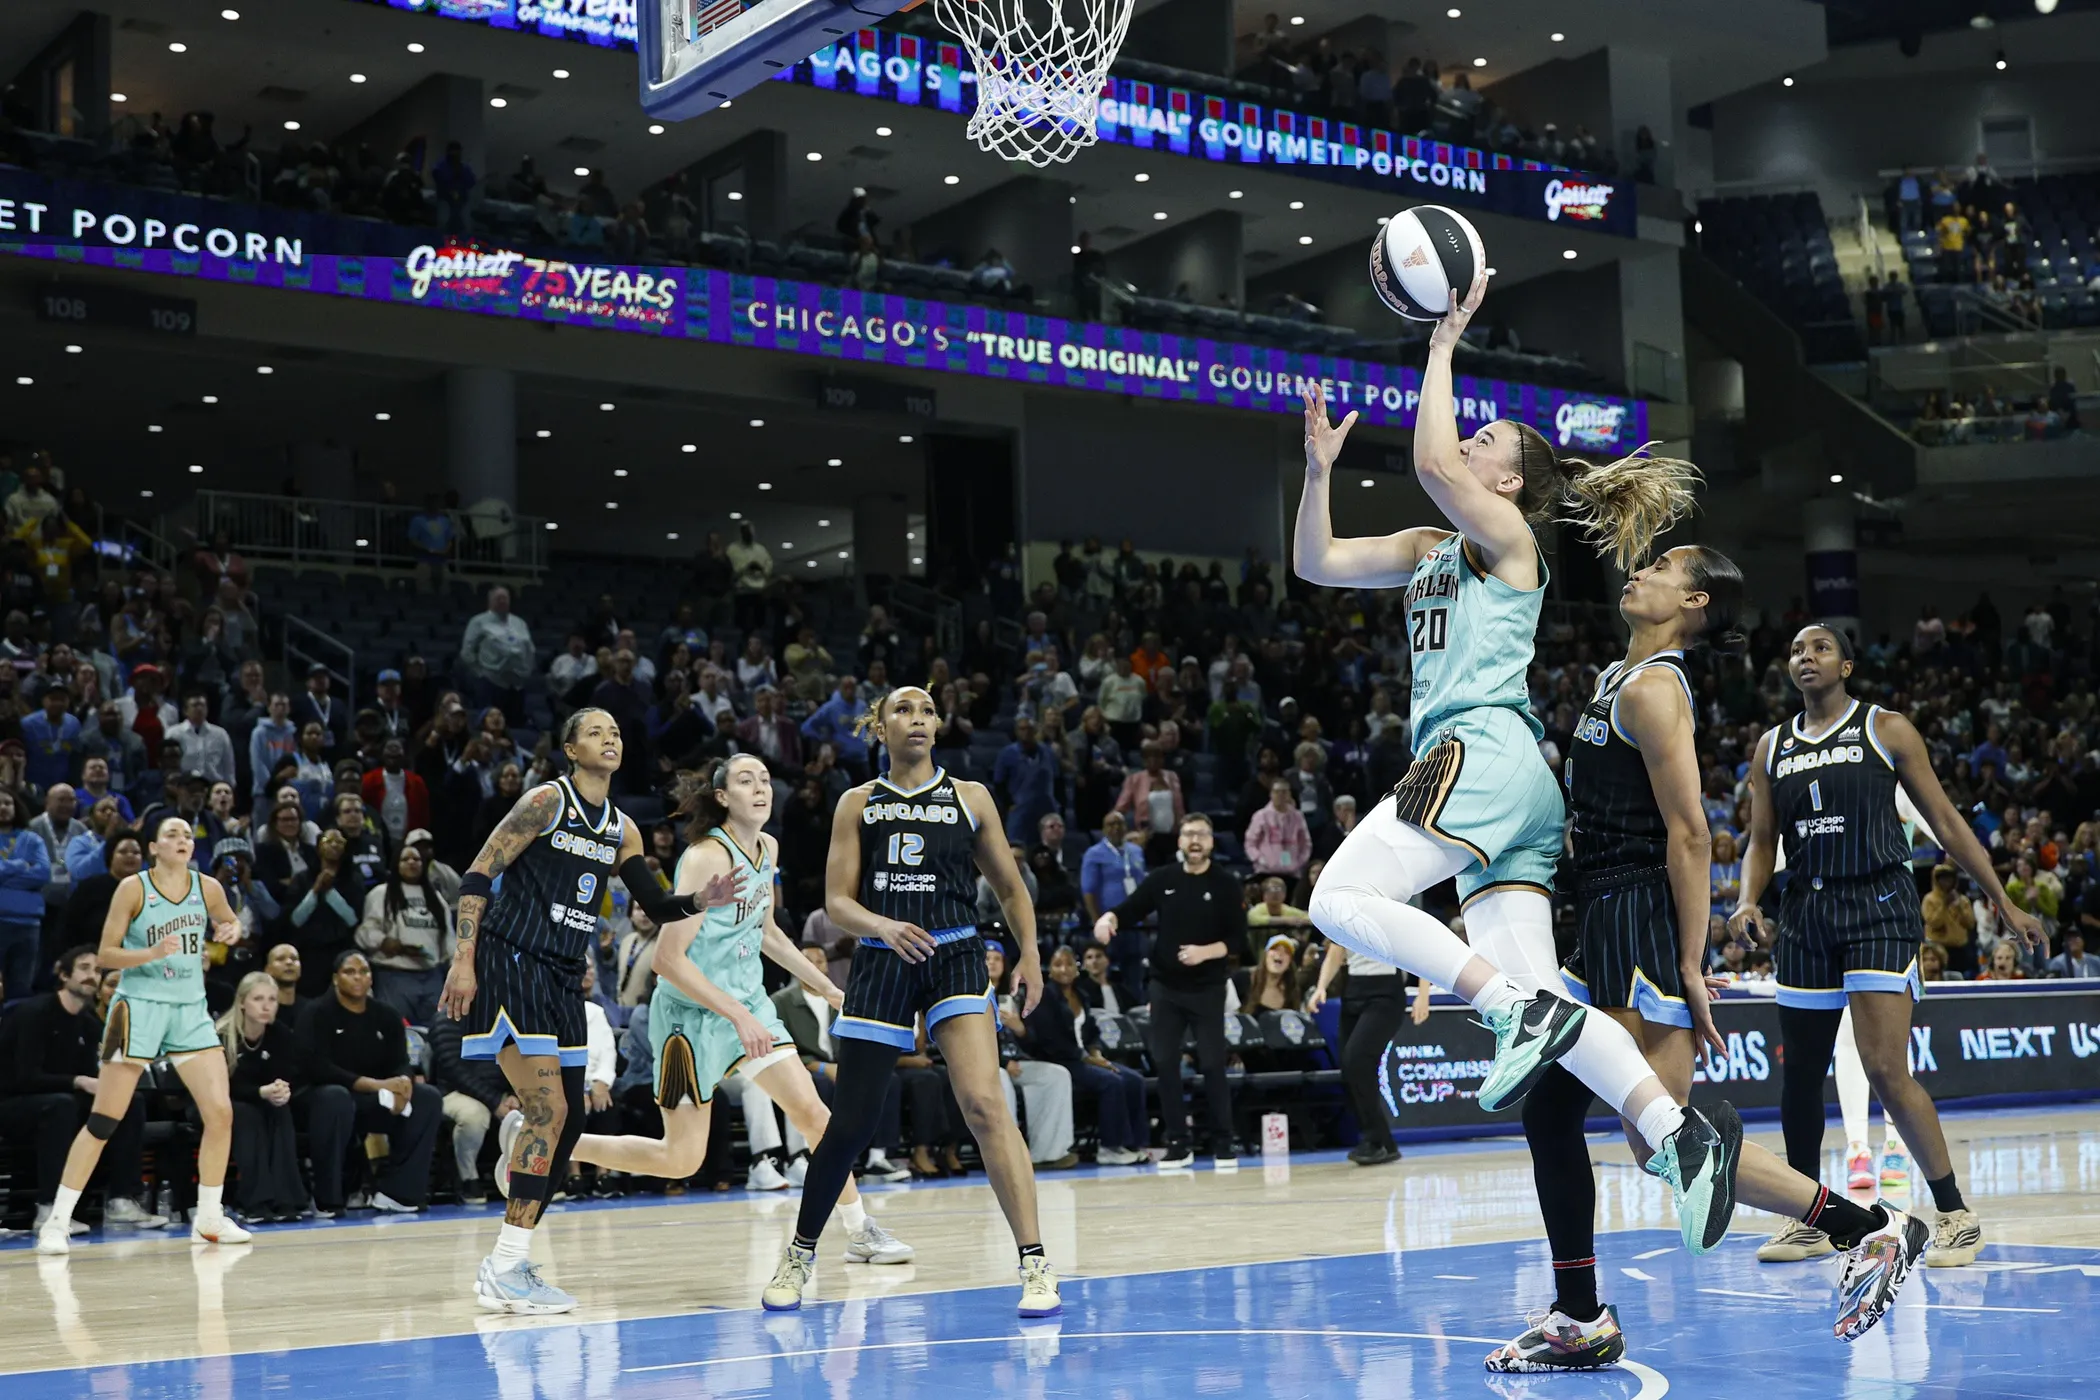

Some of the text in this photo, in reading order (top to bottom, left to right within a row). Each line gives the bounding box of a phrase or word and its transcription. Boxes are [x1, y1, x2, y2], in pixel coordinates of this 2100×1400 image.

[807, 45, 943, 90] CAGO'S
[1199, 117, 1344, 167] GOURMET
[1355, 146, 1487, 194] POPCORN
[72, 208, 302, 266] POPCORN
[44, 296, 191, 332] 108 109
[405, 244, 524, 300] Garrett
[746, 301, 949, 352] CHICAGO'S
[1208, 363, 1352, 404] GOURMET
[1364, 384, 1498, 422] POPRN
[1411, 606, 1449, 655] 20
[1776, 745, 1864, 779] CHICAGO
[1809, 779, 1823, 812] 1
[863, 803, 959, 825] CHICAGO
[551, 830, 617, 865] CHICAG
[888, 832, 925, 866] 12
[576, 872, 598, 904] 9
[890, 872, 936, 883] UChicago
[890, 882, 936, 892] Medicine
[181, 933, 199, 955] 18
[1395, 1044, 1446, 1059] WNBA
[1960, 1026, 2056, 1060] NEXT
[1398, 1059, 1495, 1081] COMMISS
[1400, 1081, 1455, 1104] CUP
